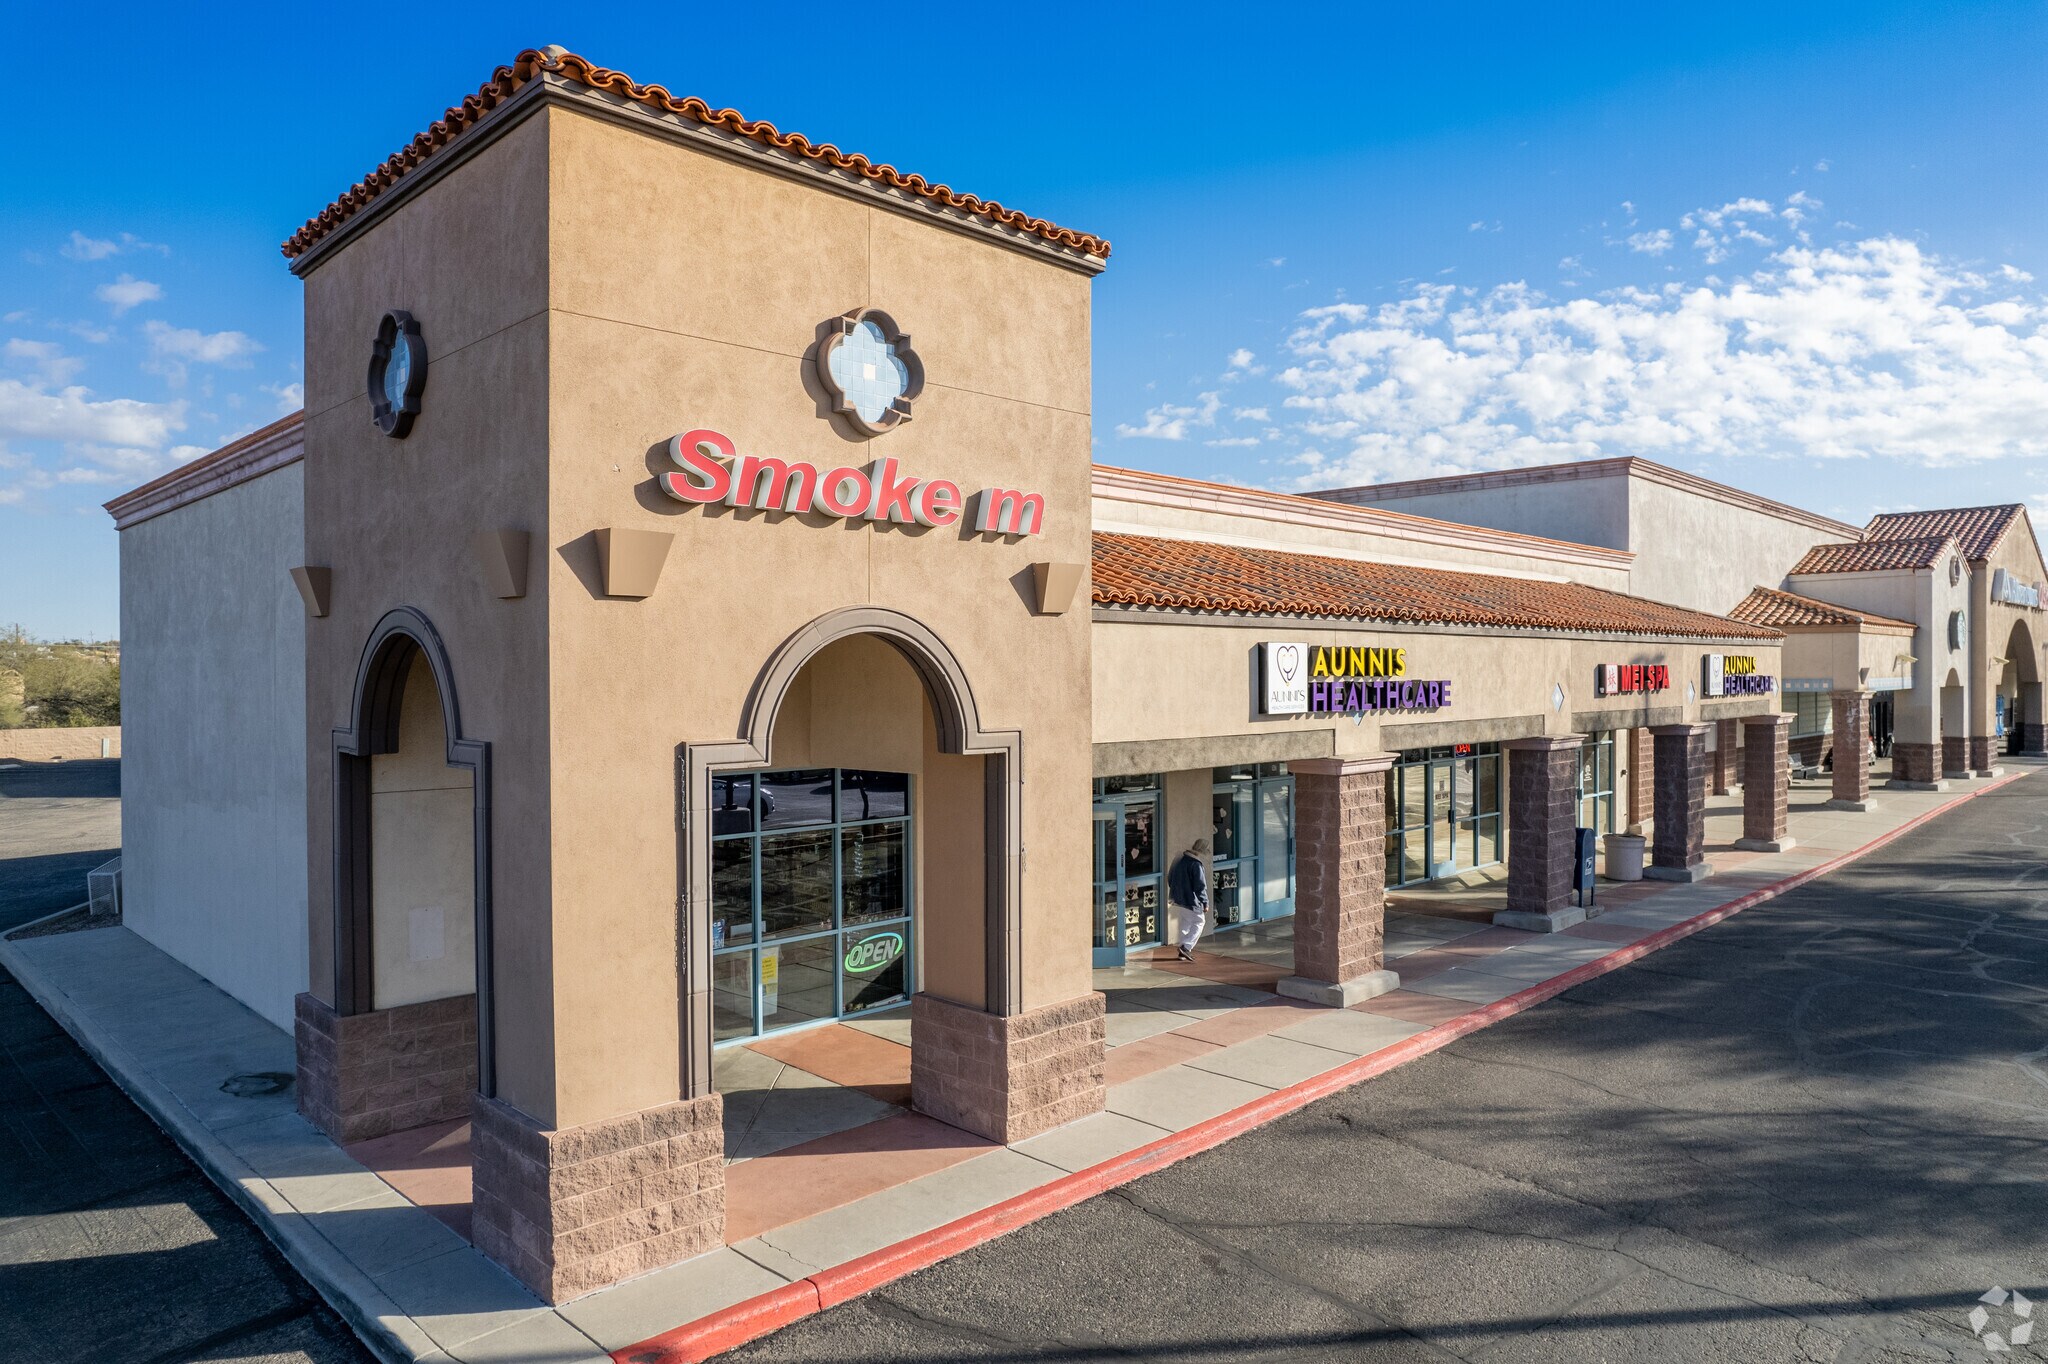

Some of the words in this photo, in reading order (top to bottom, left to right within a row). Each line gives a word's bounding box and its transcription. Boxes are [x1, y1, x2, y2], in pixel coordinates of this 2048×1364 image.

[660, 429, 962, 527] Smoke
[977, 486, 1045, 535] m
[1312, 645, 1407, 677] AUNNIS
[1724, 655, 1757, 674] AUNNIS
[1621, 664, 1644, 691] MEI
[1648, 664, 1670, 690] SPA
[1725, 675, 1774, 694] HEALTHCARE
[1312, 679, 1452, 712] HEALTHCARE
[848, 937, 897, 967] OPEN
